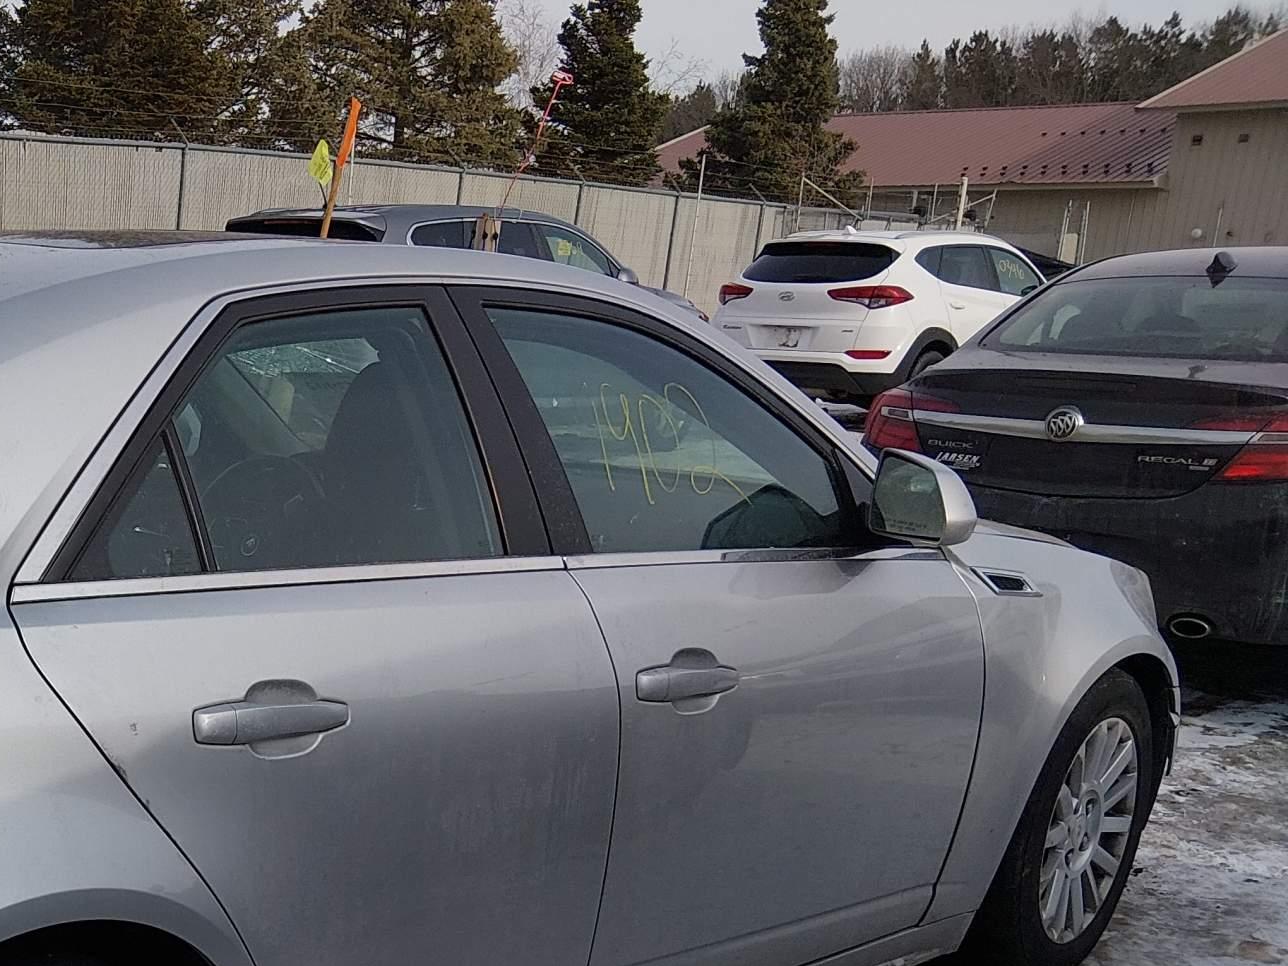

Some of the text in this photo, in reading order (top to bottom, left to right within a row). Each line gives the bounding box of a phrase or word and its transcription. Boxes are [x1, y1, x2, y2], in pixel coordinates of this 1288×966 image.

[927, 439, 975, 449] BUICK
[935, 451, 982, 464] LARSEN
[1137, 455, 1200, 465] REGAL
